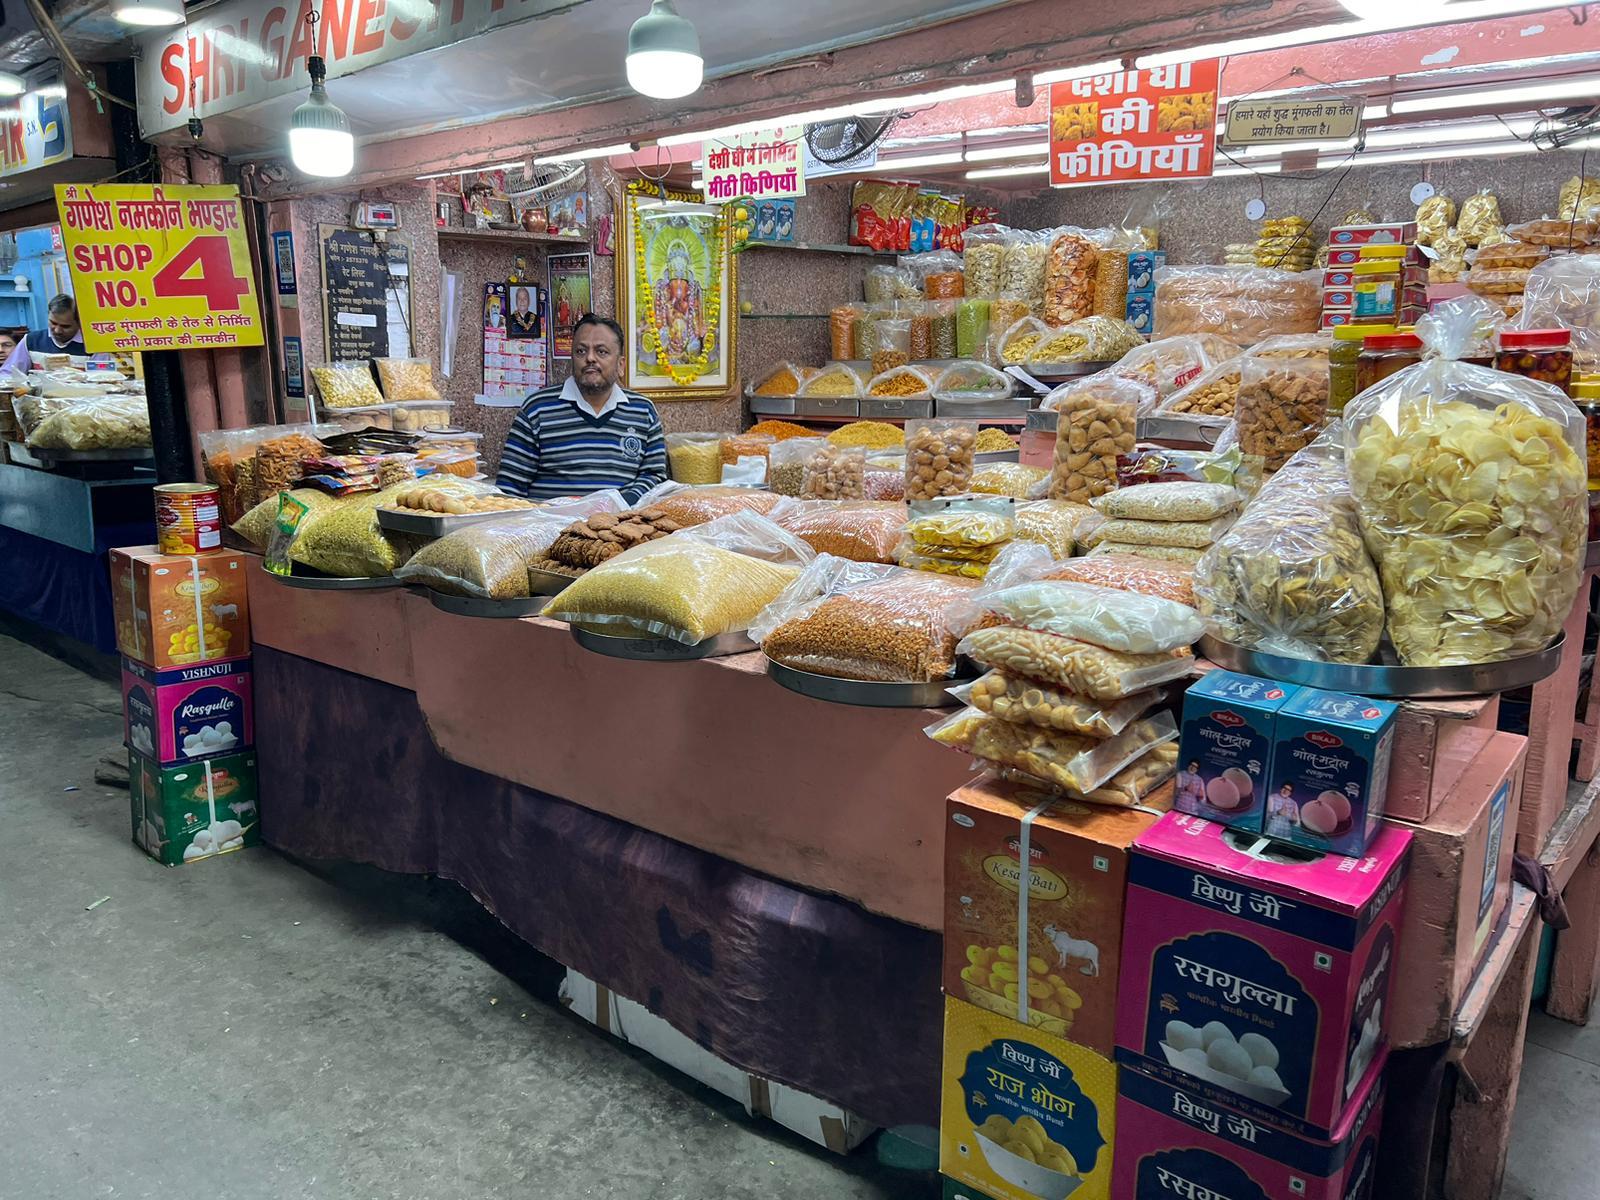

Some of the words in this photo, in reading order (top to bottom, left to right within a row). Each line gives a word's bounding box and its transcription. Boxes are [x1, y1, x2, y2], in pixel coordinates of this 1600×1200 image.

[160, 18, 247, 115] SHRI
[260, 0, 440, 82] GANE
[1101, 97, 1155, 135] की
[1235, 108, 1255, 121] हमारे
[1256, 107, 1271, 120] यहाँ
[1274, 108, 1289, 122] शुद्ध
[1292, 104, 1323, 120] मूंगफली
[1325, 106, 1336, 116] का
[1339, 103, 1353, 116] तेल
[1252, 125, 1273, 136] प्रयोग
[1274, 123, 1294, 136] किया
[1297, 124, 1316, 135] जाता
[708, 148, 730, 170] देशी
[732, 145, 745, 167] घी
[747, 142, 757, 165] में
[1058, 134, 1204, 178] फीणियाँ
[65, 186, 77, 199] श्री
[708, 173, 738, 198] मीठी
[63, 189, 113, 231] गणेश
[116, 187, 184, 231] नमकीन
[187, 199, 239, 232] भण्डार
[74, 244, 153, 272] SHOP
[152, 236, 250, 311] 4
[95, 280, 147, 308] NO.
[91, 321, 116, 333] शुद्ध
[120, 316, 163, 333] मूंगफली
[167, 315, 178, 328] के
[182, 315, 200, 328] तेल
[203, 315, 214, 328] से
[217, 314, 251, 327] निर्मित
[114, 335, 139, 348] सभी
[144, 335, 173, 347] प्रकार
[178, 333, 192, 345] की
[195, 331, 236, 344] नमकीन
[182, 663, 232, 680] VISHNUJI
[181, 697, 235, 718] Rasgulla
[992, 862, 1021, 881] Kesa
[1031, 875, 1057, 892] Bati
[1192, 874, 1245, 914] विष्णु
[1250, 892, 1296, 920] जी
[1174, 955, 1297, 1016] रसगुल्ला
[1002, 1043, 1036, 1073] विष्णु
[1039, 1058, 1065, 1080] जी
[987, 1067, 1026, 1099] राज
[1031, 1082, 1075, 1120] भोग
[1173, 1091, 1225, 1134] विष्णु
[1227, 1115, 1272, 1144] जी
